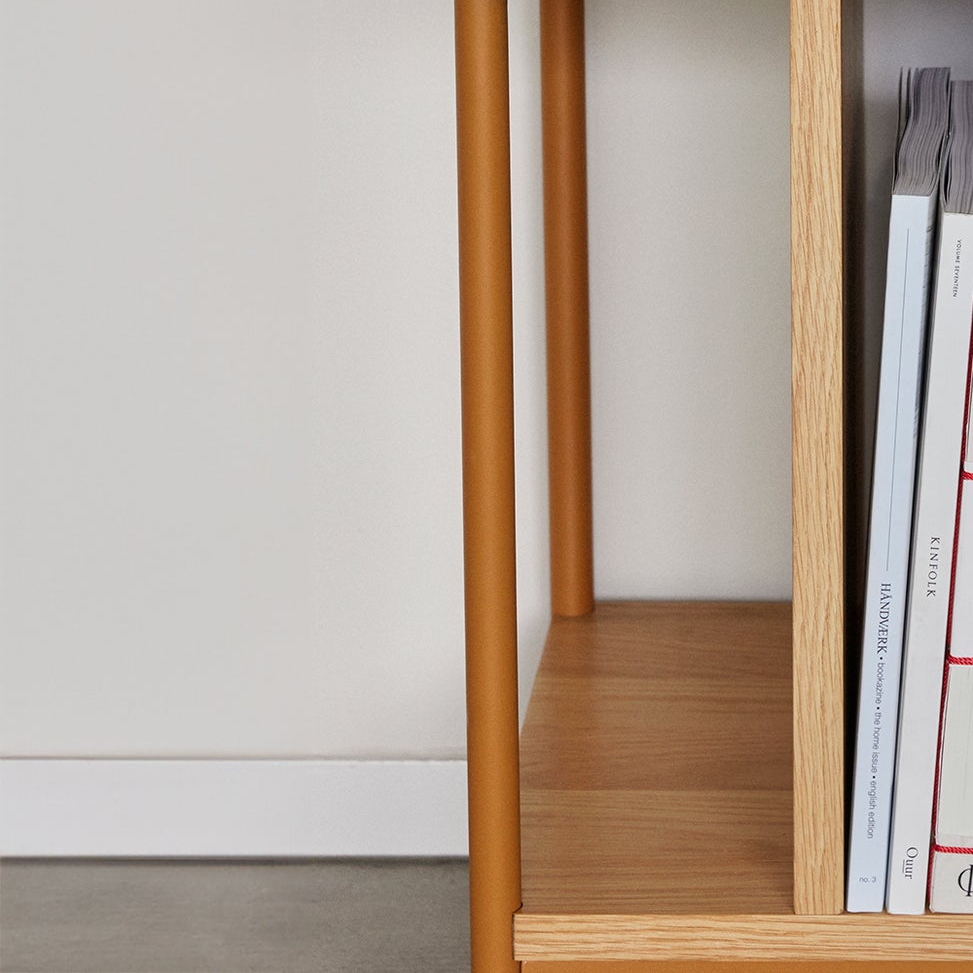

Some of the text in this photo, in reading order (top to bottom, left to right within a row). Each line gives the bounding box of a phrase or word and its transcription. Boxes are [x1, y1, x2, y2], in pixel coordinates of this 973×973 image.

[926, 536, 941, 597] KINFOLK
[867, 583, 892, 839] HÅNDVÆRK bookazine the home issue english edition
[902, 846, 919, 880] Ouur
